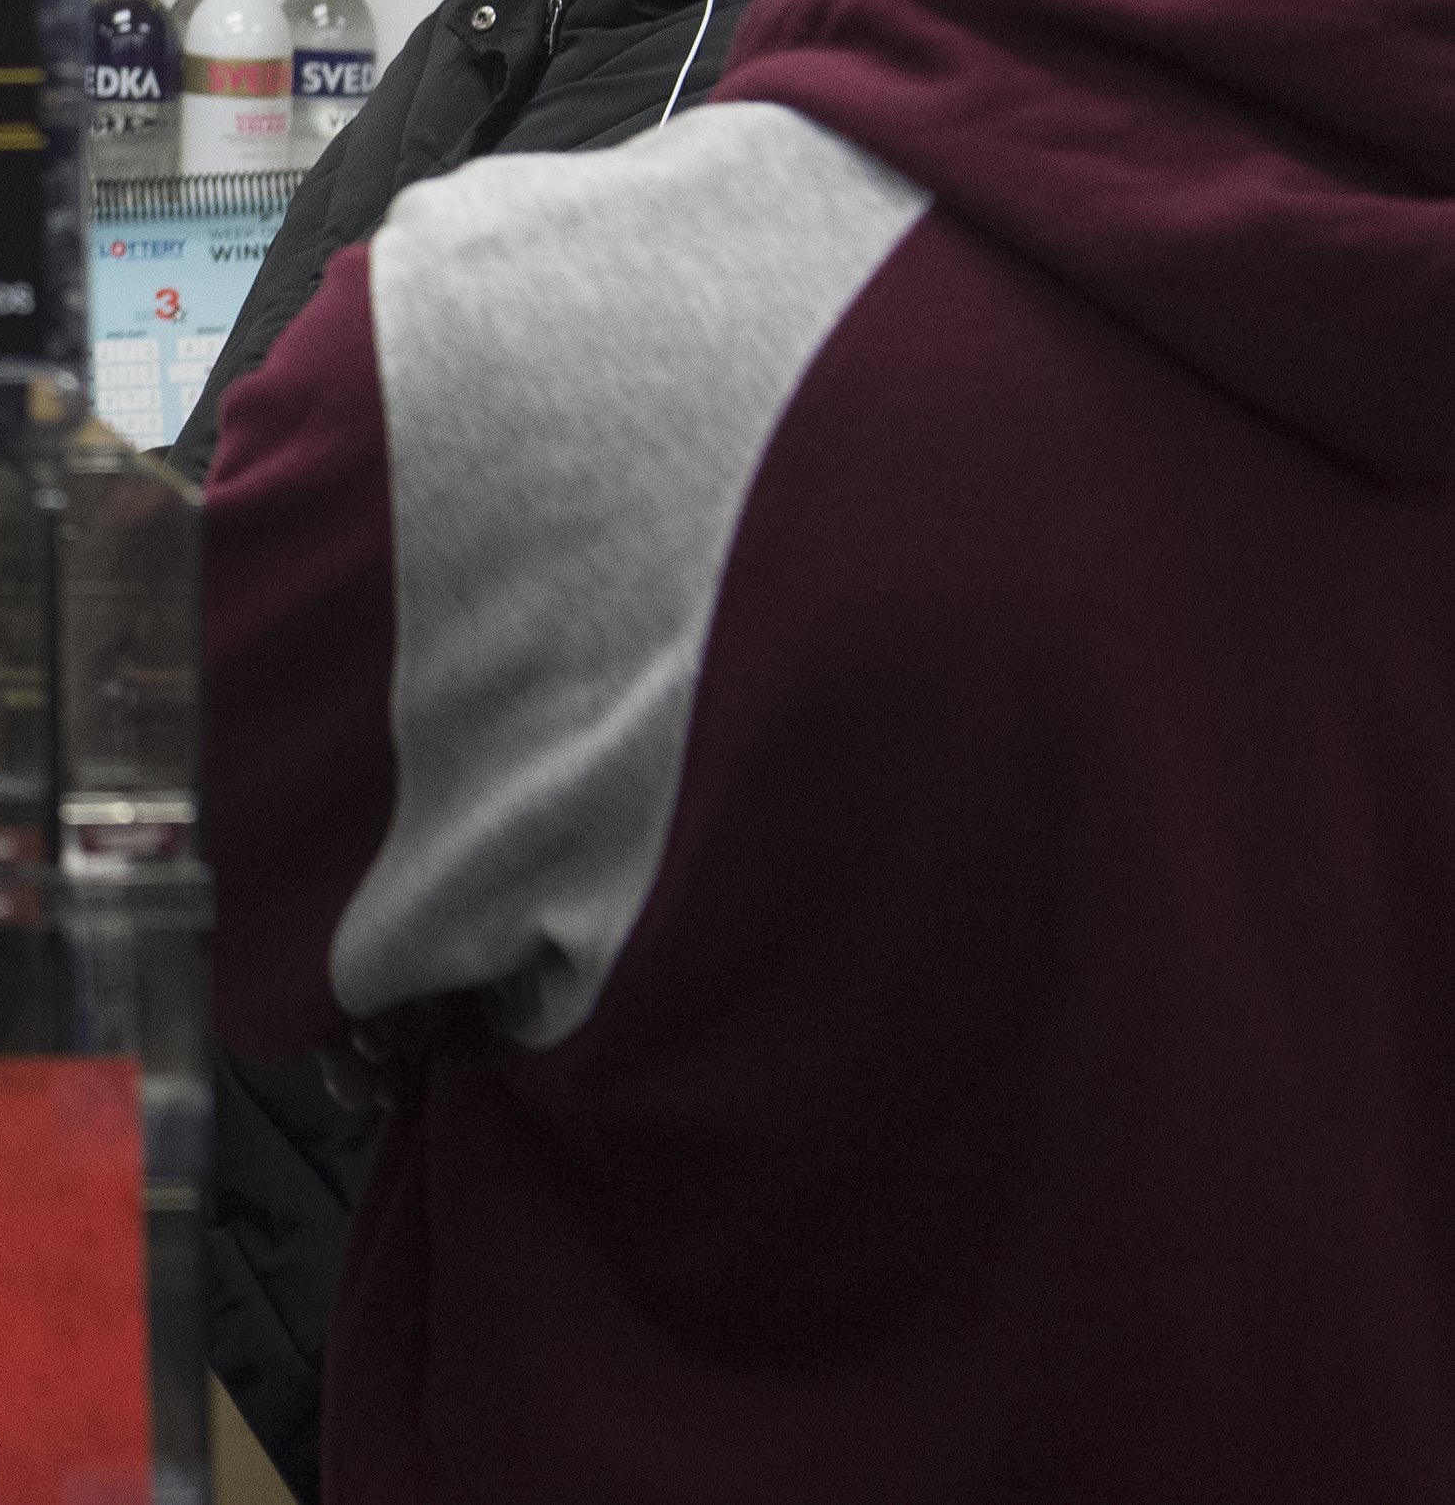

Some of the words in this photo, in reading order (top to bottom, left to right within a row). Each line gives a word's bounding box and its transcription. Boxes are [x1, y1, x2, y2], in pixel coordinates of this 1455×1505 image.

[86, 65, 161, 99] EDKA
[301, 61, 377, 95] SVED
[99, 238, 187, 261] LOTTERY
[154, 287, 181, 321] 3
